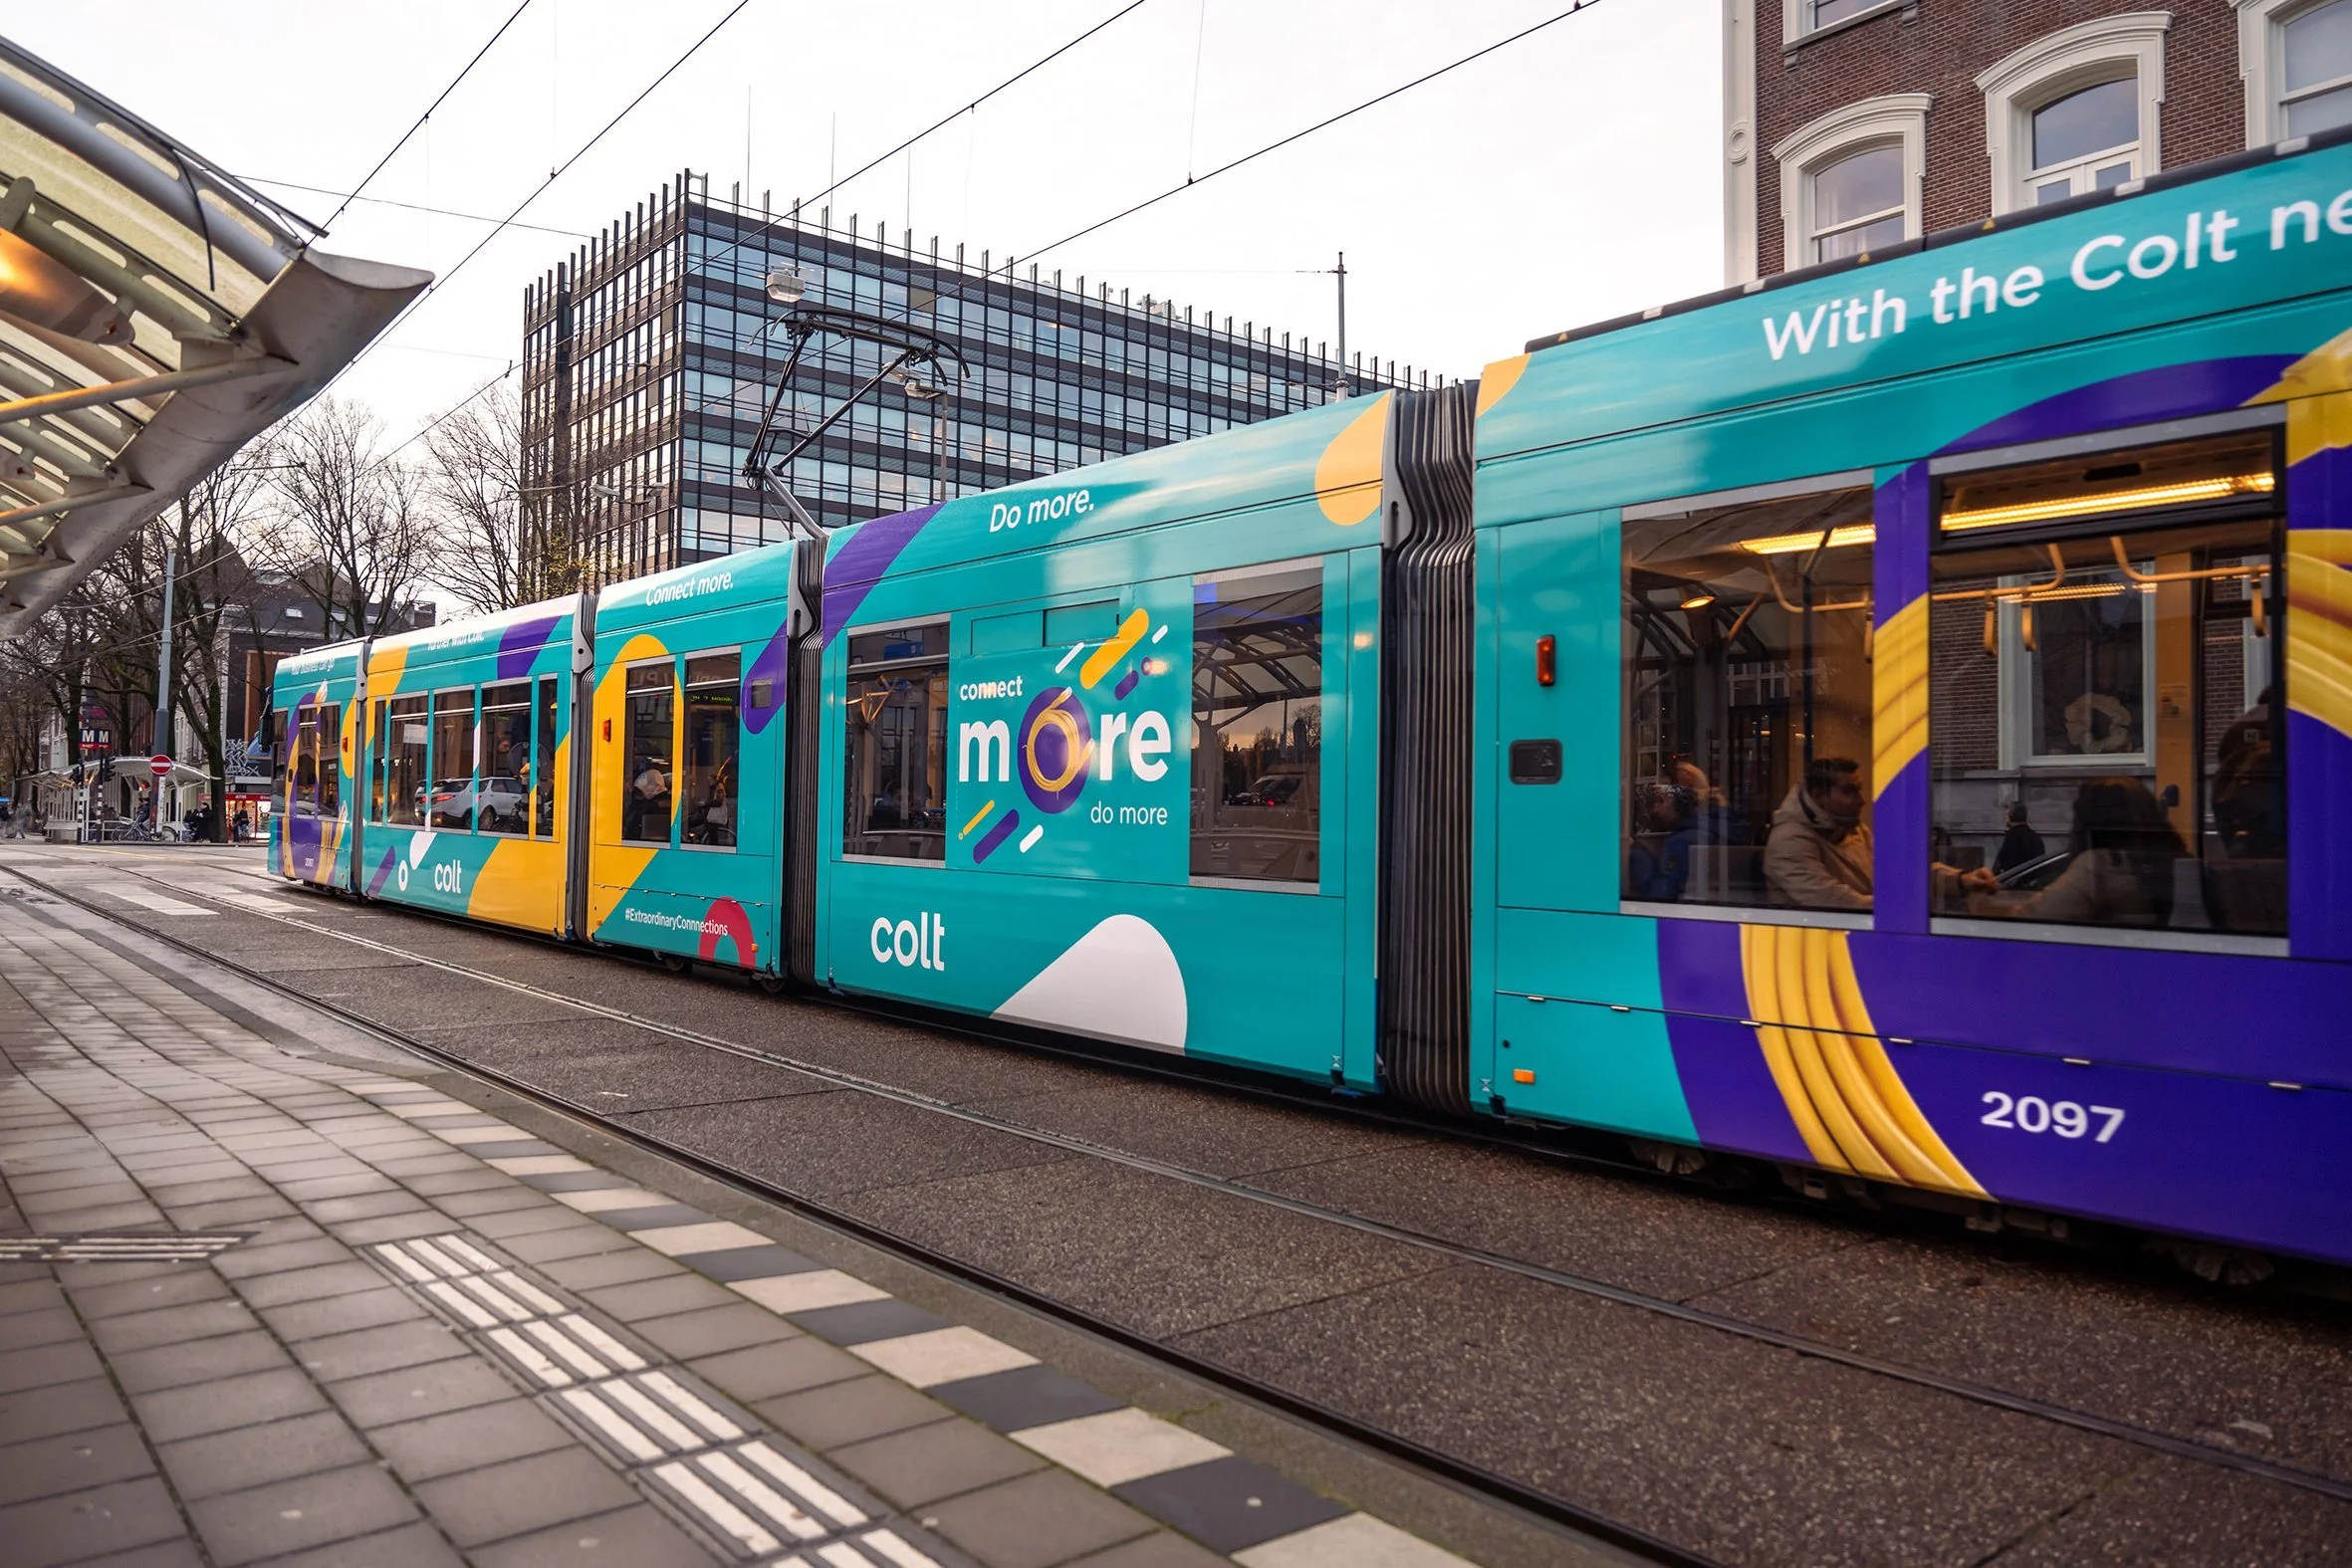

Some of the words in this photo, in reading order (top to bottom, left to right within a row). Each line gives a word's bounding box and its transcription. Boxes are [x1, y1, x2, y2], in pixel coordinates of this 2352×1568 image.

[1763, 289, 1905, 360] With
[1930, 265, 2044, 325] the
[2070, 211, 2238, 292] Colt
[2270, 189, 2352, 251] ne
[989, 502, 1022, 534] Do
[1027, 488, 1095, 526] more.
[645, 576, 696, 606] Connect
[697, 571, 734, 595] more.
[960, 675, 1024, 701] connect
[83, 730, 95, 743] M
[99, 731, 110, 744] M
[958, 689, 1172, 794] more
[1090, 800, 1113, 825] do
[1119, 805, 1168, 826] more
[434, 859, 462, 894] colt
[871, 911, 945, 972] colt
[1982, 1090, 2126, 1144] 2097
